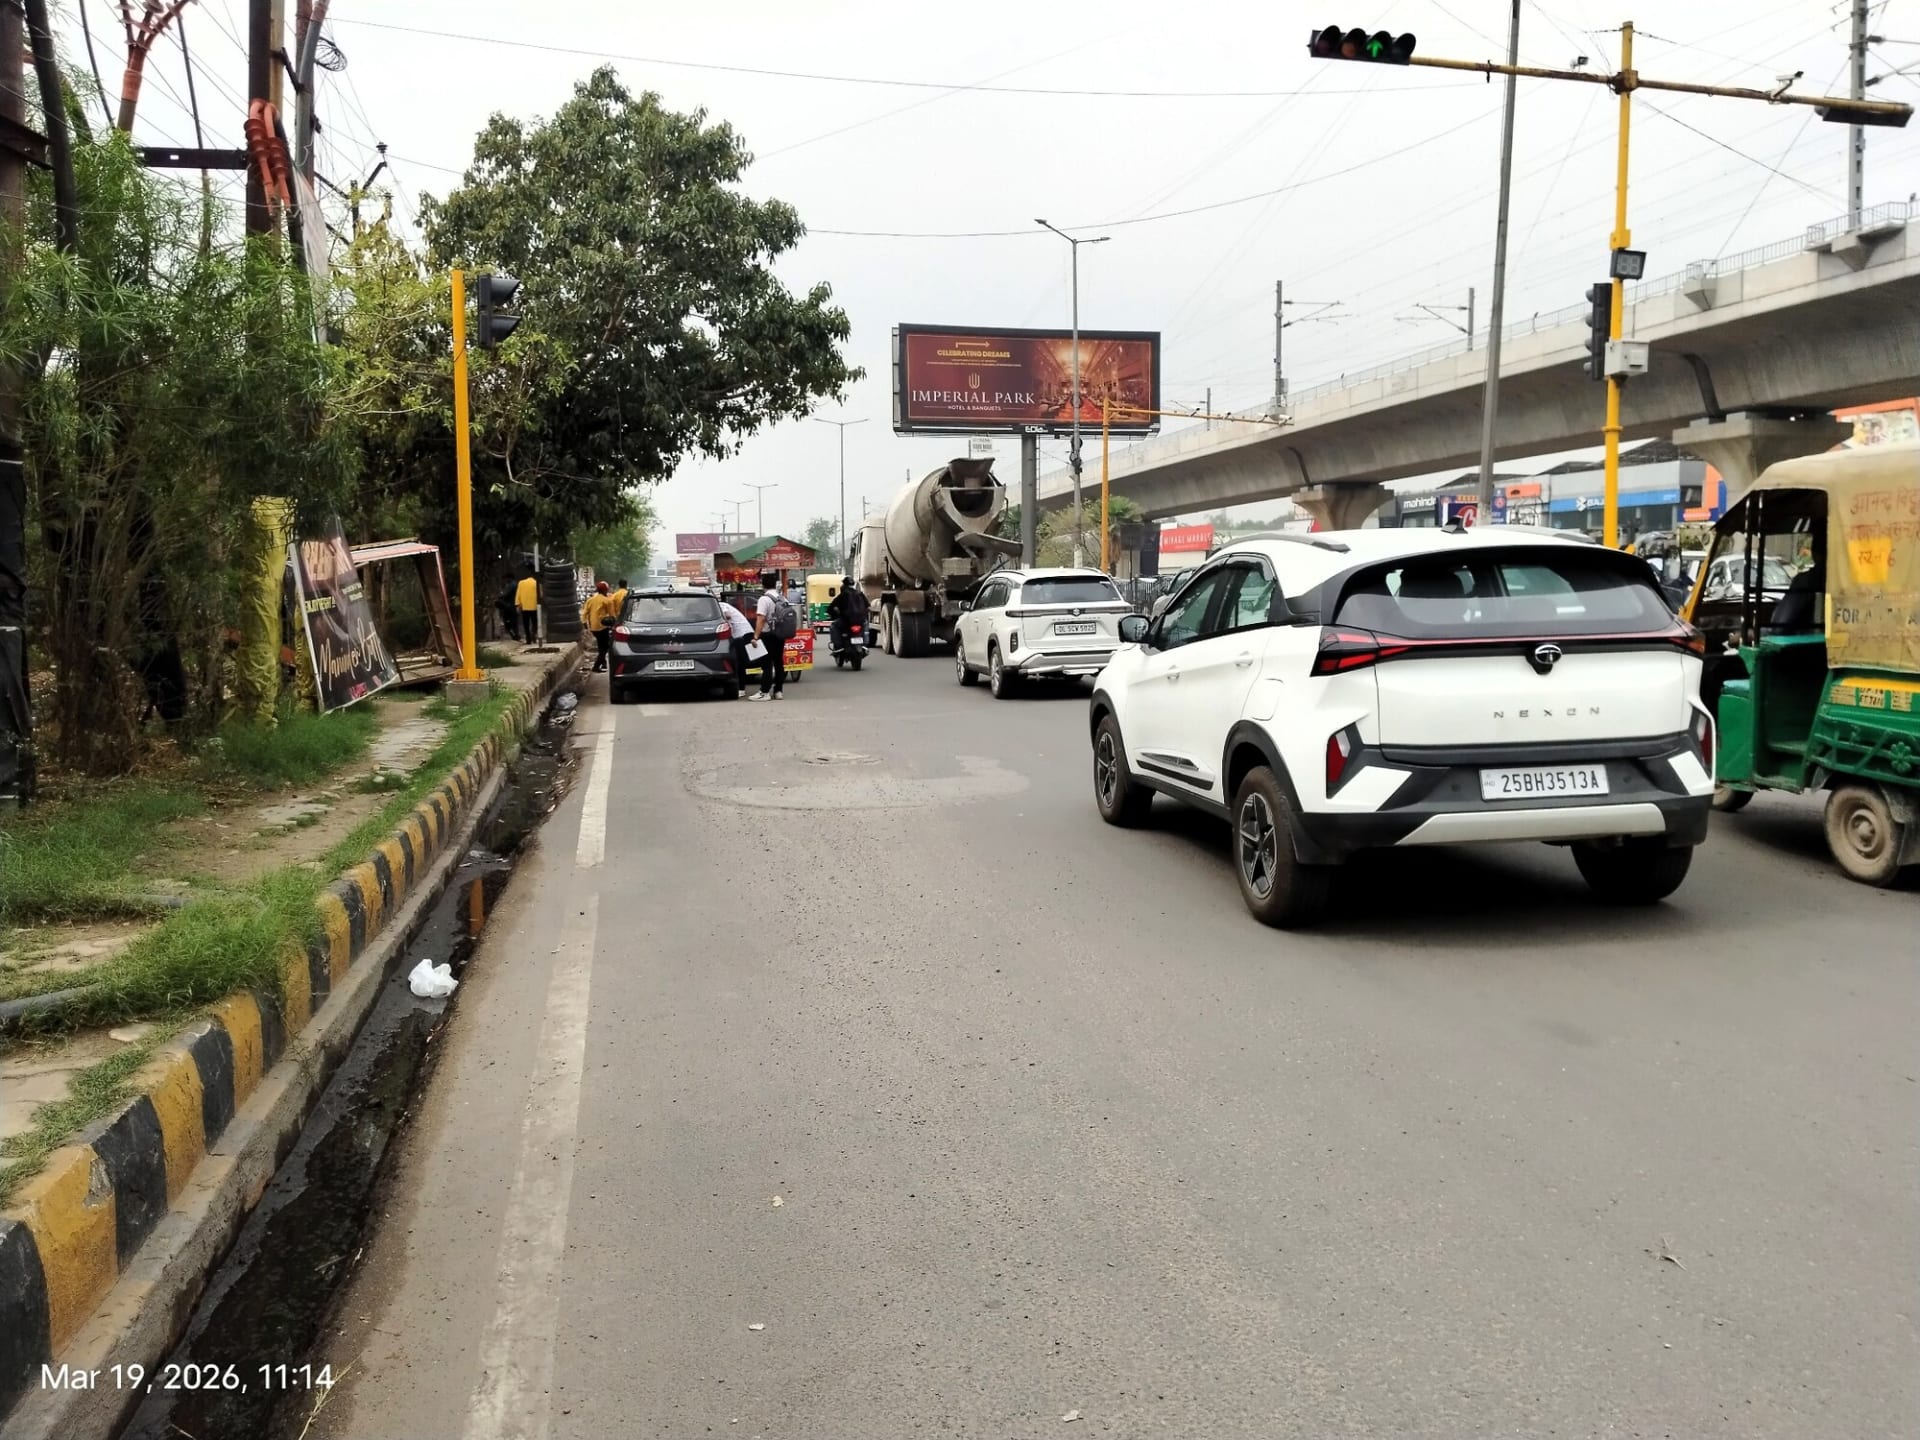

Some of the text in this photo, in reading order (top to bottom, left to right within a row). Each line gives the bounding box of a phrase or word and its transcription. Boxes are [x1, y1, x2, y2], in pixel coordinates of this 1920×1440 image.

[912, 390, 1036, 404] IMPERIAL PARK
[1834, 608, 1860, 624] FOR
[1494, 706, 1600, 719] NEXON
[1501, 770, 1599, 793] 25BH3513A
